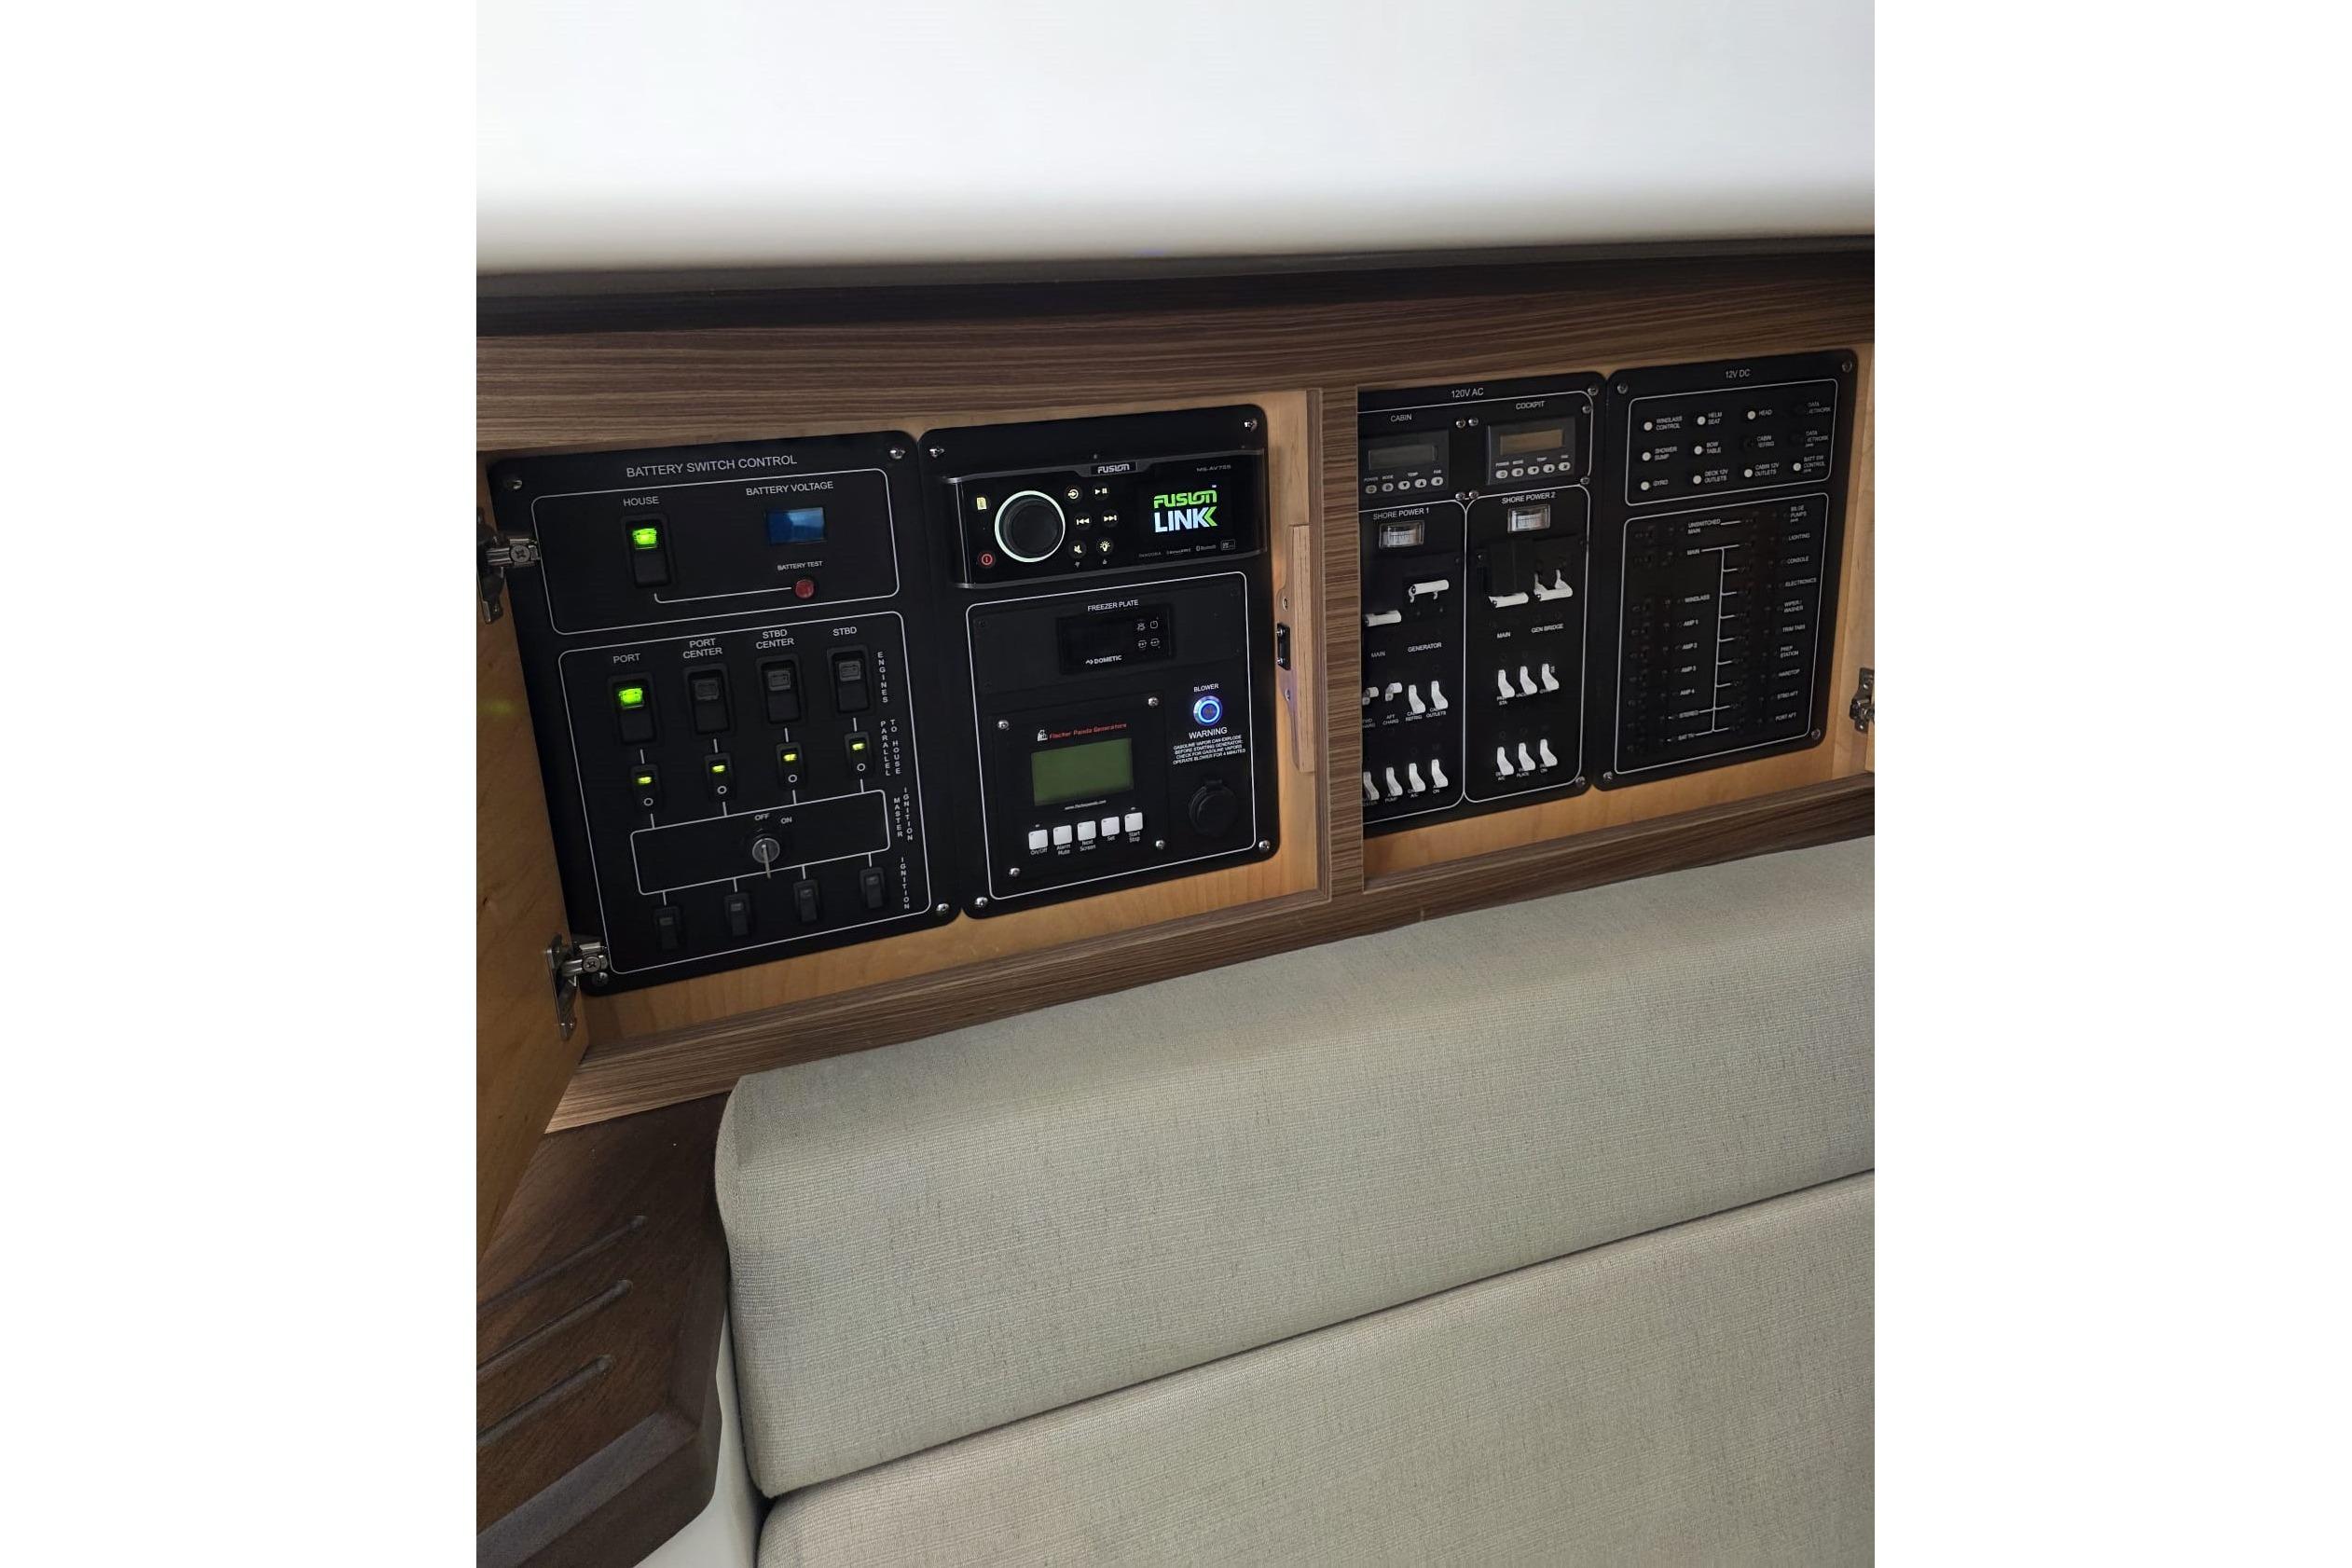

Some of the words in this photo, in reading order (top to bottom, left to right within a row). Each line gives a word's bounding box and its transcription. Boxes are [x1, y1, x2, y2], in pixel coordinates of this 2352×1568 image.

[1451, 389, 1470, 398] 120V
[1472, 388, 1484, 396] AC
[1516, 401, 1546, 410] COCKPIT
[1391, 414, 1411, 422] CABIN
[626, 463, 682, 478] BATTERY
[686, 461, 736, 474] SWITCH
[738, 455, 798, 470] CONTROL
[746, 484, 789, 497] BATTERY
[791, 481, 833, 494] VOLTAGE
[623, 496, 660, 507] HOUSE
[1502, 496, 1524, 504] SHORE
[1526, 493, 1549, 502] POWER
[1154, 506, 1217, 533] LINK
[1373, 511, 1396, 520] SHORE
[1398, 509, 1424, 517] POWER
[1788, 532, 1810, 541] LIGHTING
[777, 561, 805, 571] BATTERY
[1087, 601, 1119, 612] FREEZER
[1119, 598, 1139, 609] PLATE
[833, 626, 858, 637] STBD
[1544, 623, 1564, 631] BRIDGE
[763, 629, 788, 640] STBD
[689, 638, 716, 649] PORT
[755, 638, 794, 649] CENTER
[1408, 641, 1441, 653] GENERATOR
[613, 653, 641, 664] PORT
[682, 647, 723, 660] CENTER
[1093, 654, 1122, 666] DOMETIC
[876, 652, 889, 703] ENGINES
[1193, 682, 1219, 693] BLOWER
[890, 719, 897, 733] TO
[1189, 727, 1228, 739] WARNING
[880, 721, 891, 777] PARALLEL
[892, 740, 901, 775] HOUSE
[753, 812, 770, 821] OFF
[893, 797, 903, 837] MASTER
[902, 787, 914, 841] IGNITION
[900, 858, 910, 910] IGNITION
